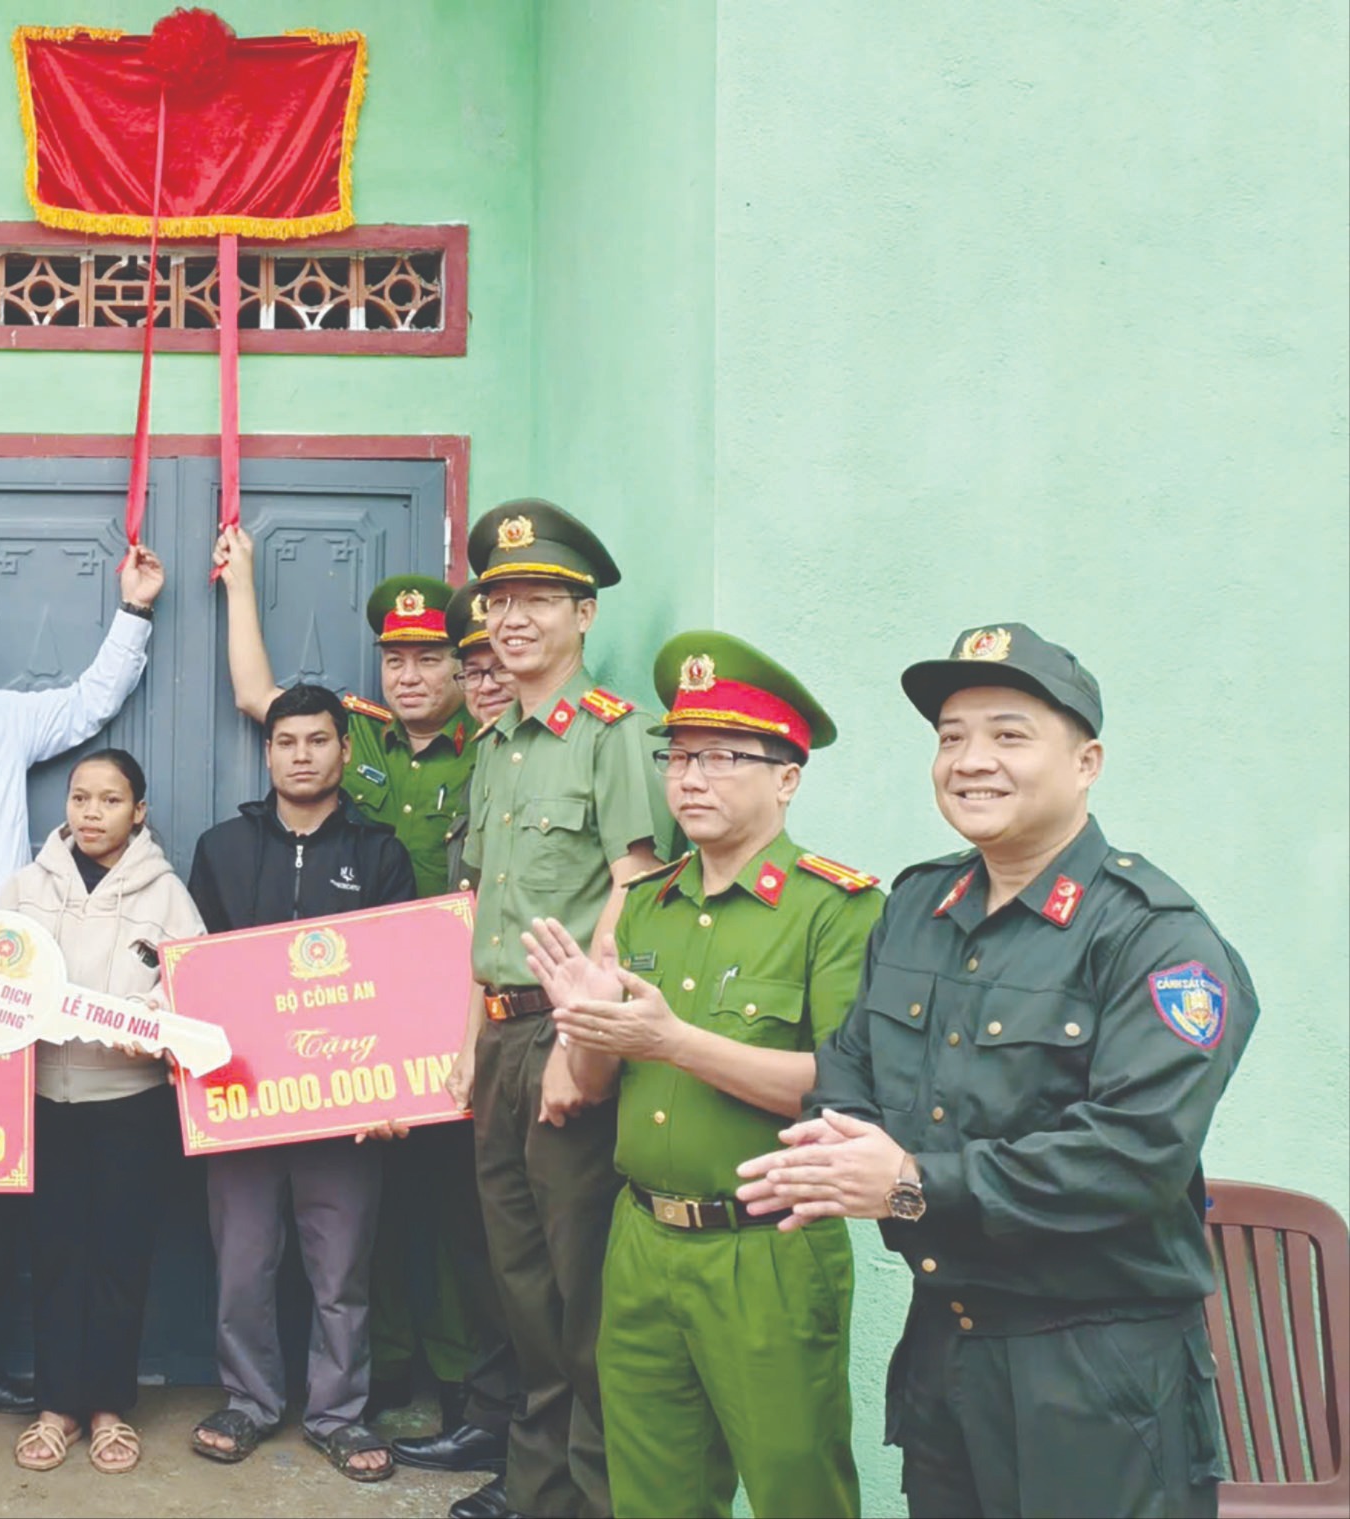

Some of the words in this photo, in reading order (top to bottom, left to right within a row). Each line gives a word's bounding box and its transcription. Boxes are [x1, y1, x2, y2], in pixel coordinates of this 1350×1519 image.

[0, 985, 33, 1007] DỊCH
[275, 988, 299, 1014] BỘ
[302, 984, 349, 1009] CÔNG
[353, 980, 376, 1001] AN
[86, 1002, 126, 1030] TRAO
[285, 1028, 378, 1064] Tặng
[205, 1063, 396, 1123] 50.000.000
[402, 1051, 459, 1097] VN
